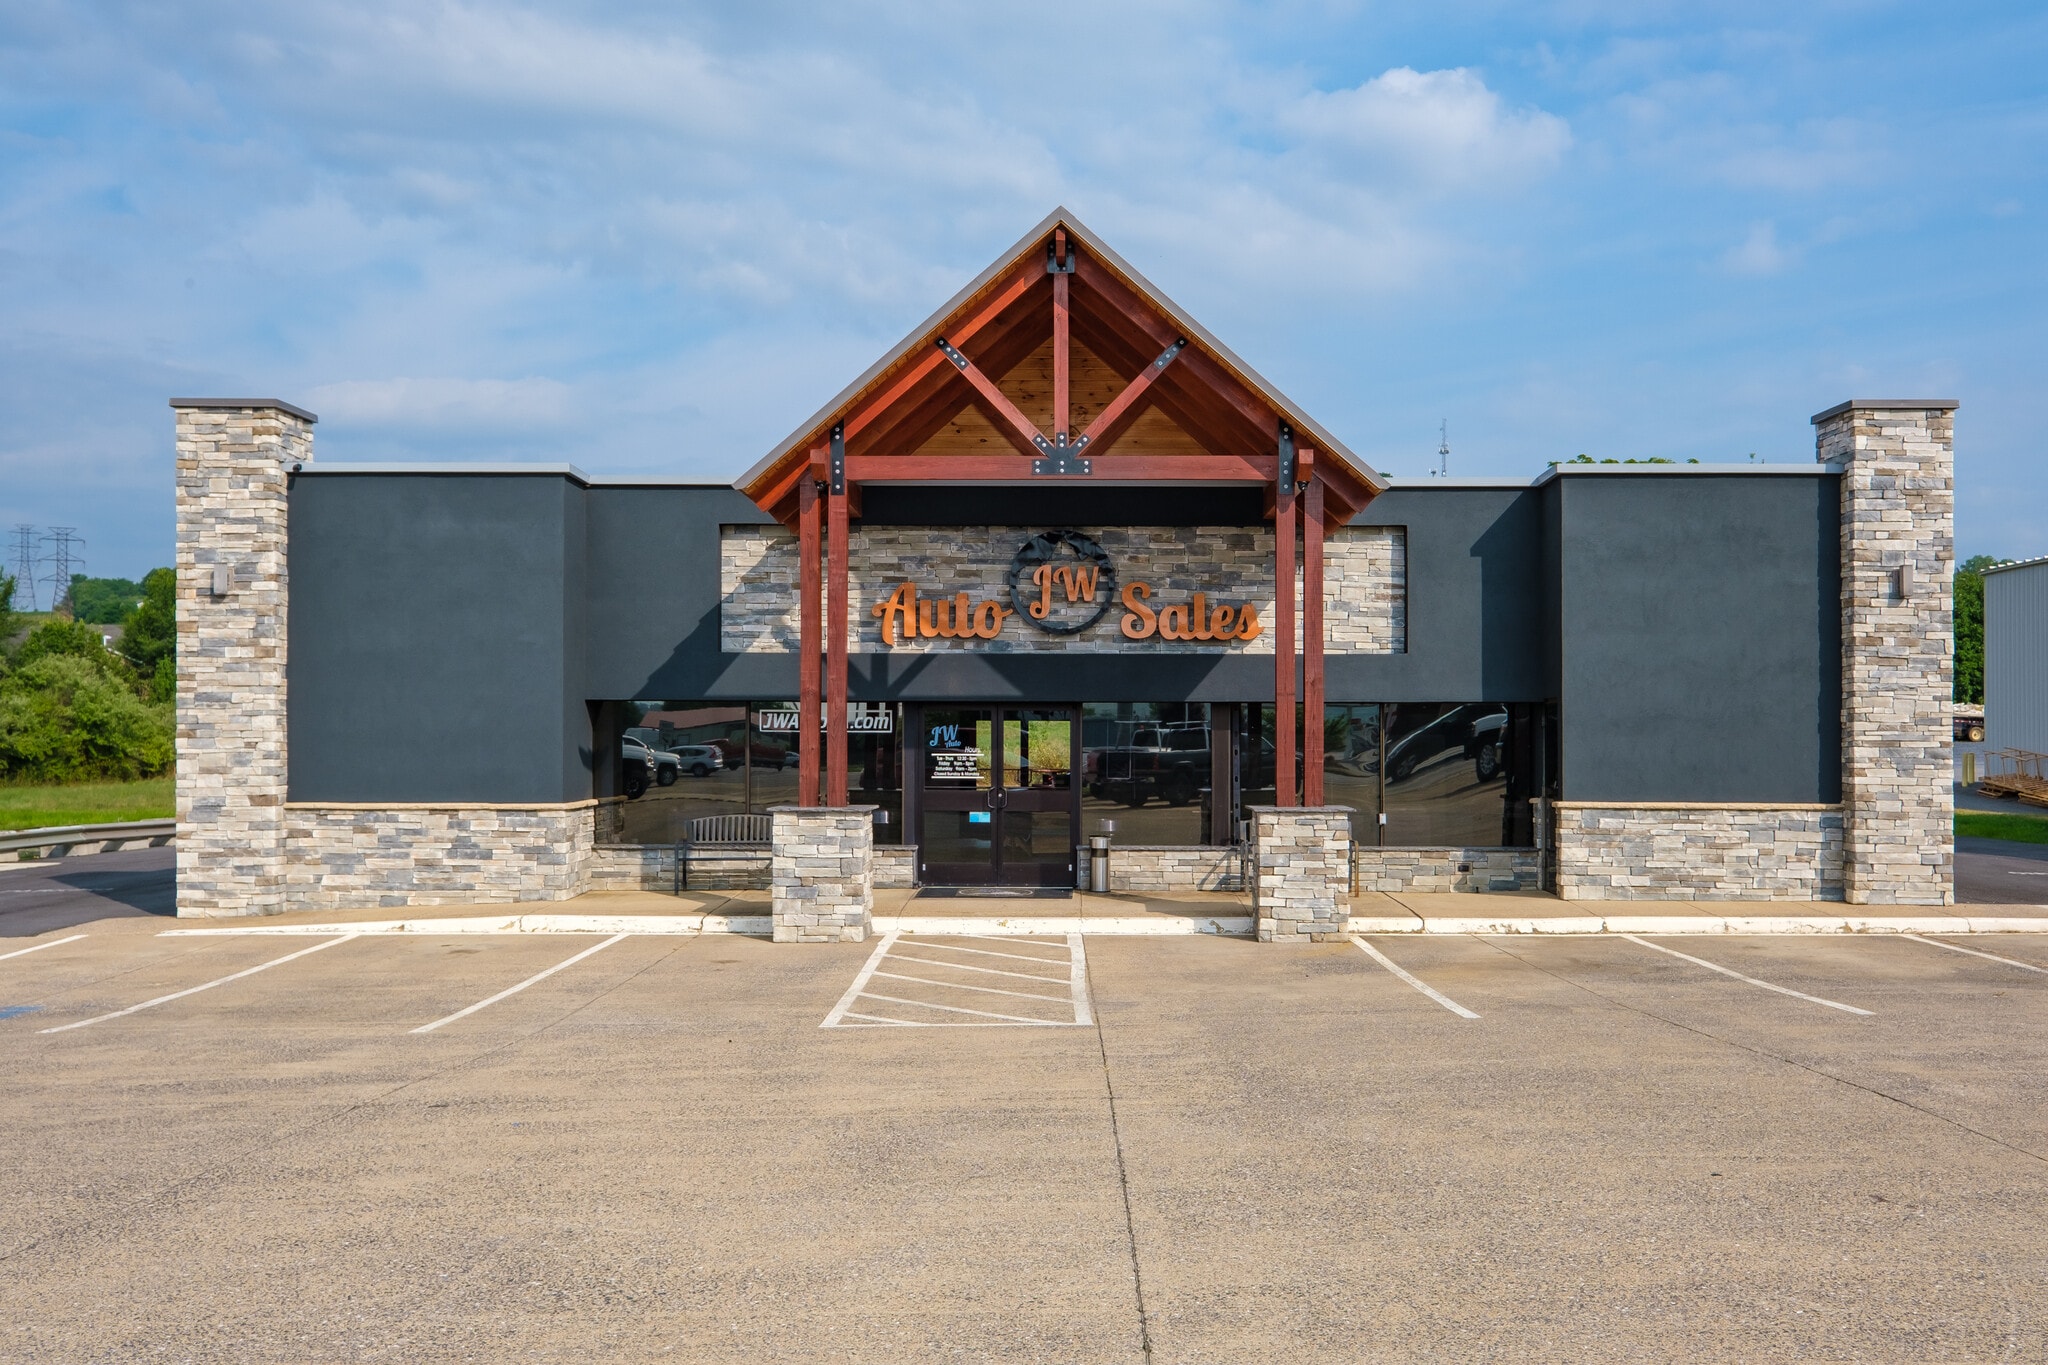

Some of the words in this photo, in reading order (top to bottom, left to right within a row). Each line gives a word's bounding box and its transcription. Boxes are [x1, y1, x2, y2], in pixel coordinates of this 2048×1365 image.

[872, 581, 1013, 645] Auto
[1030, 565, 1099, 619] JW
[1121, 581, 1264, 640] Sales
[929, 724, 959, 747] JW
[945, 740, 961, 749] Auto
